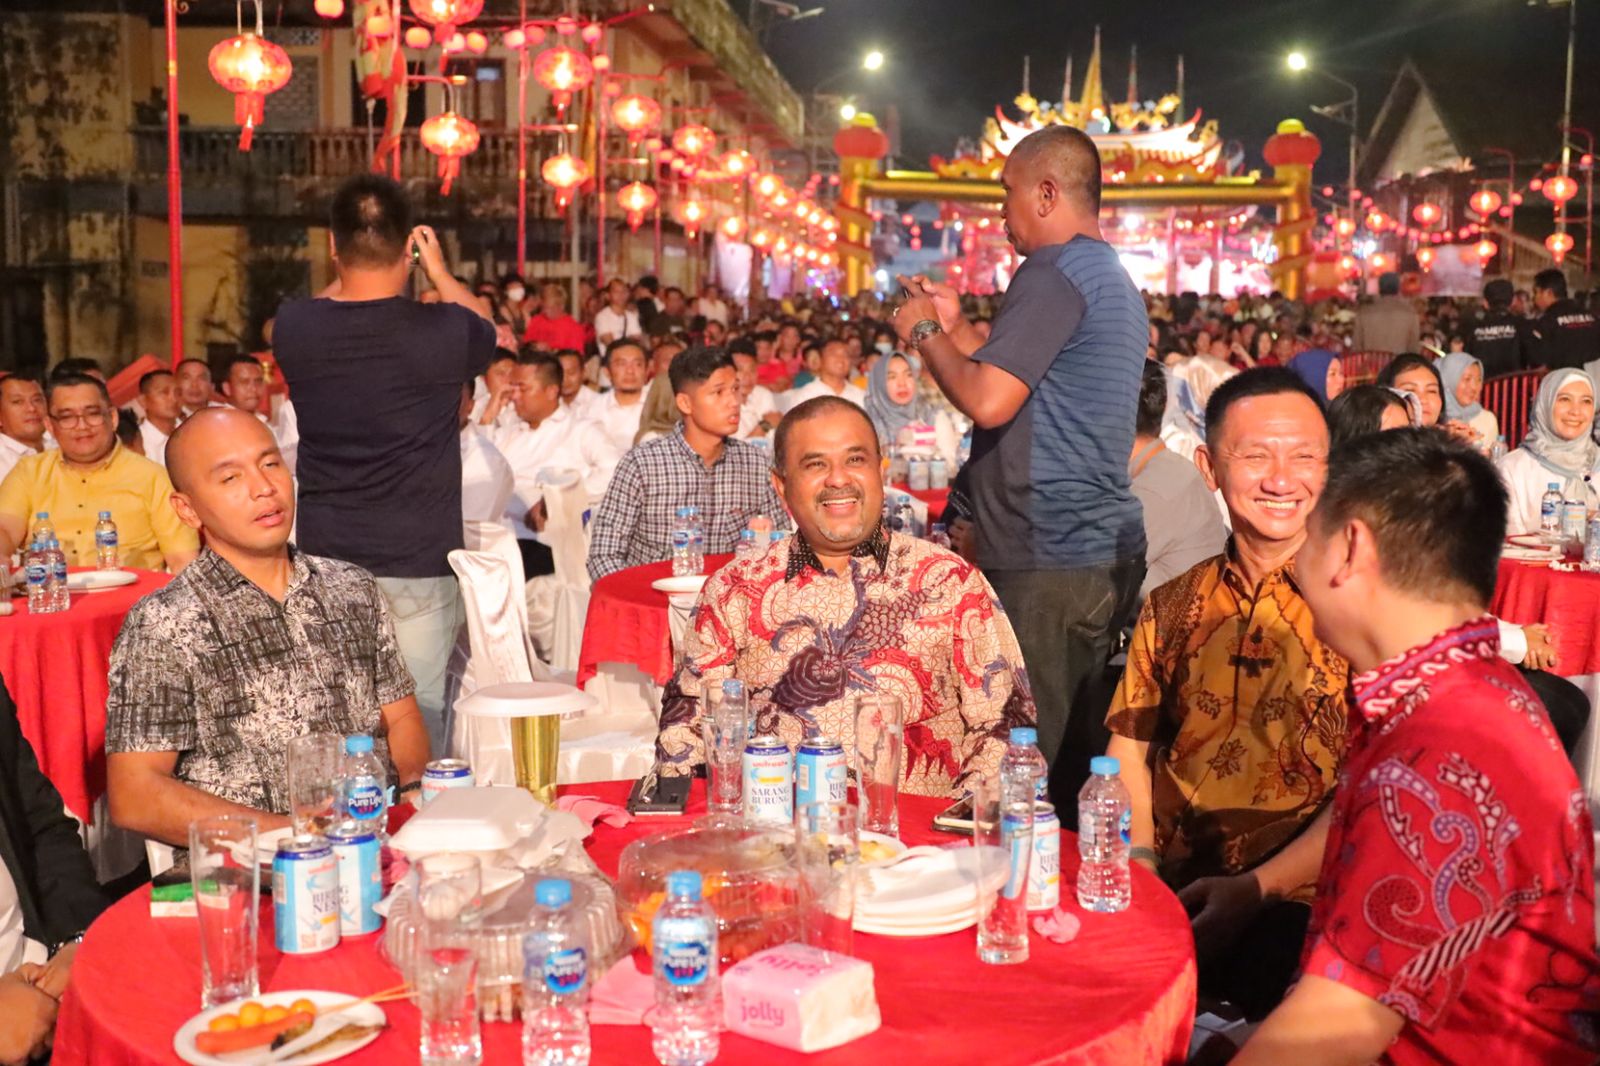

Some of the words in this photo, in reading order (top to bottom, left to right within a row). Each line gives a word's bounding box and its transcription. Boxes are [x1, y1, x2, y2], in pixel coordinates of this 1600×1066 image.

[751, 786, 790, 797] SARANG
[751, 796, 790, 805] BURUNG
[740, 998, 785, 1026] jolly
